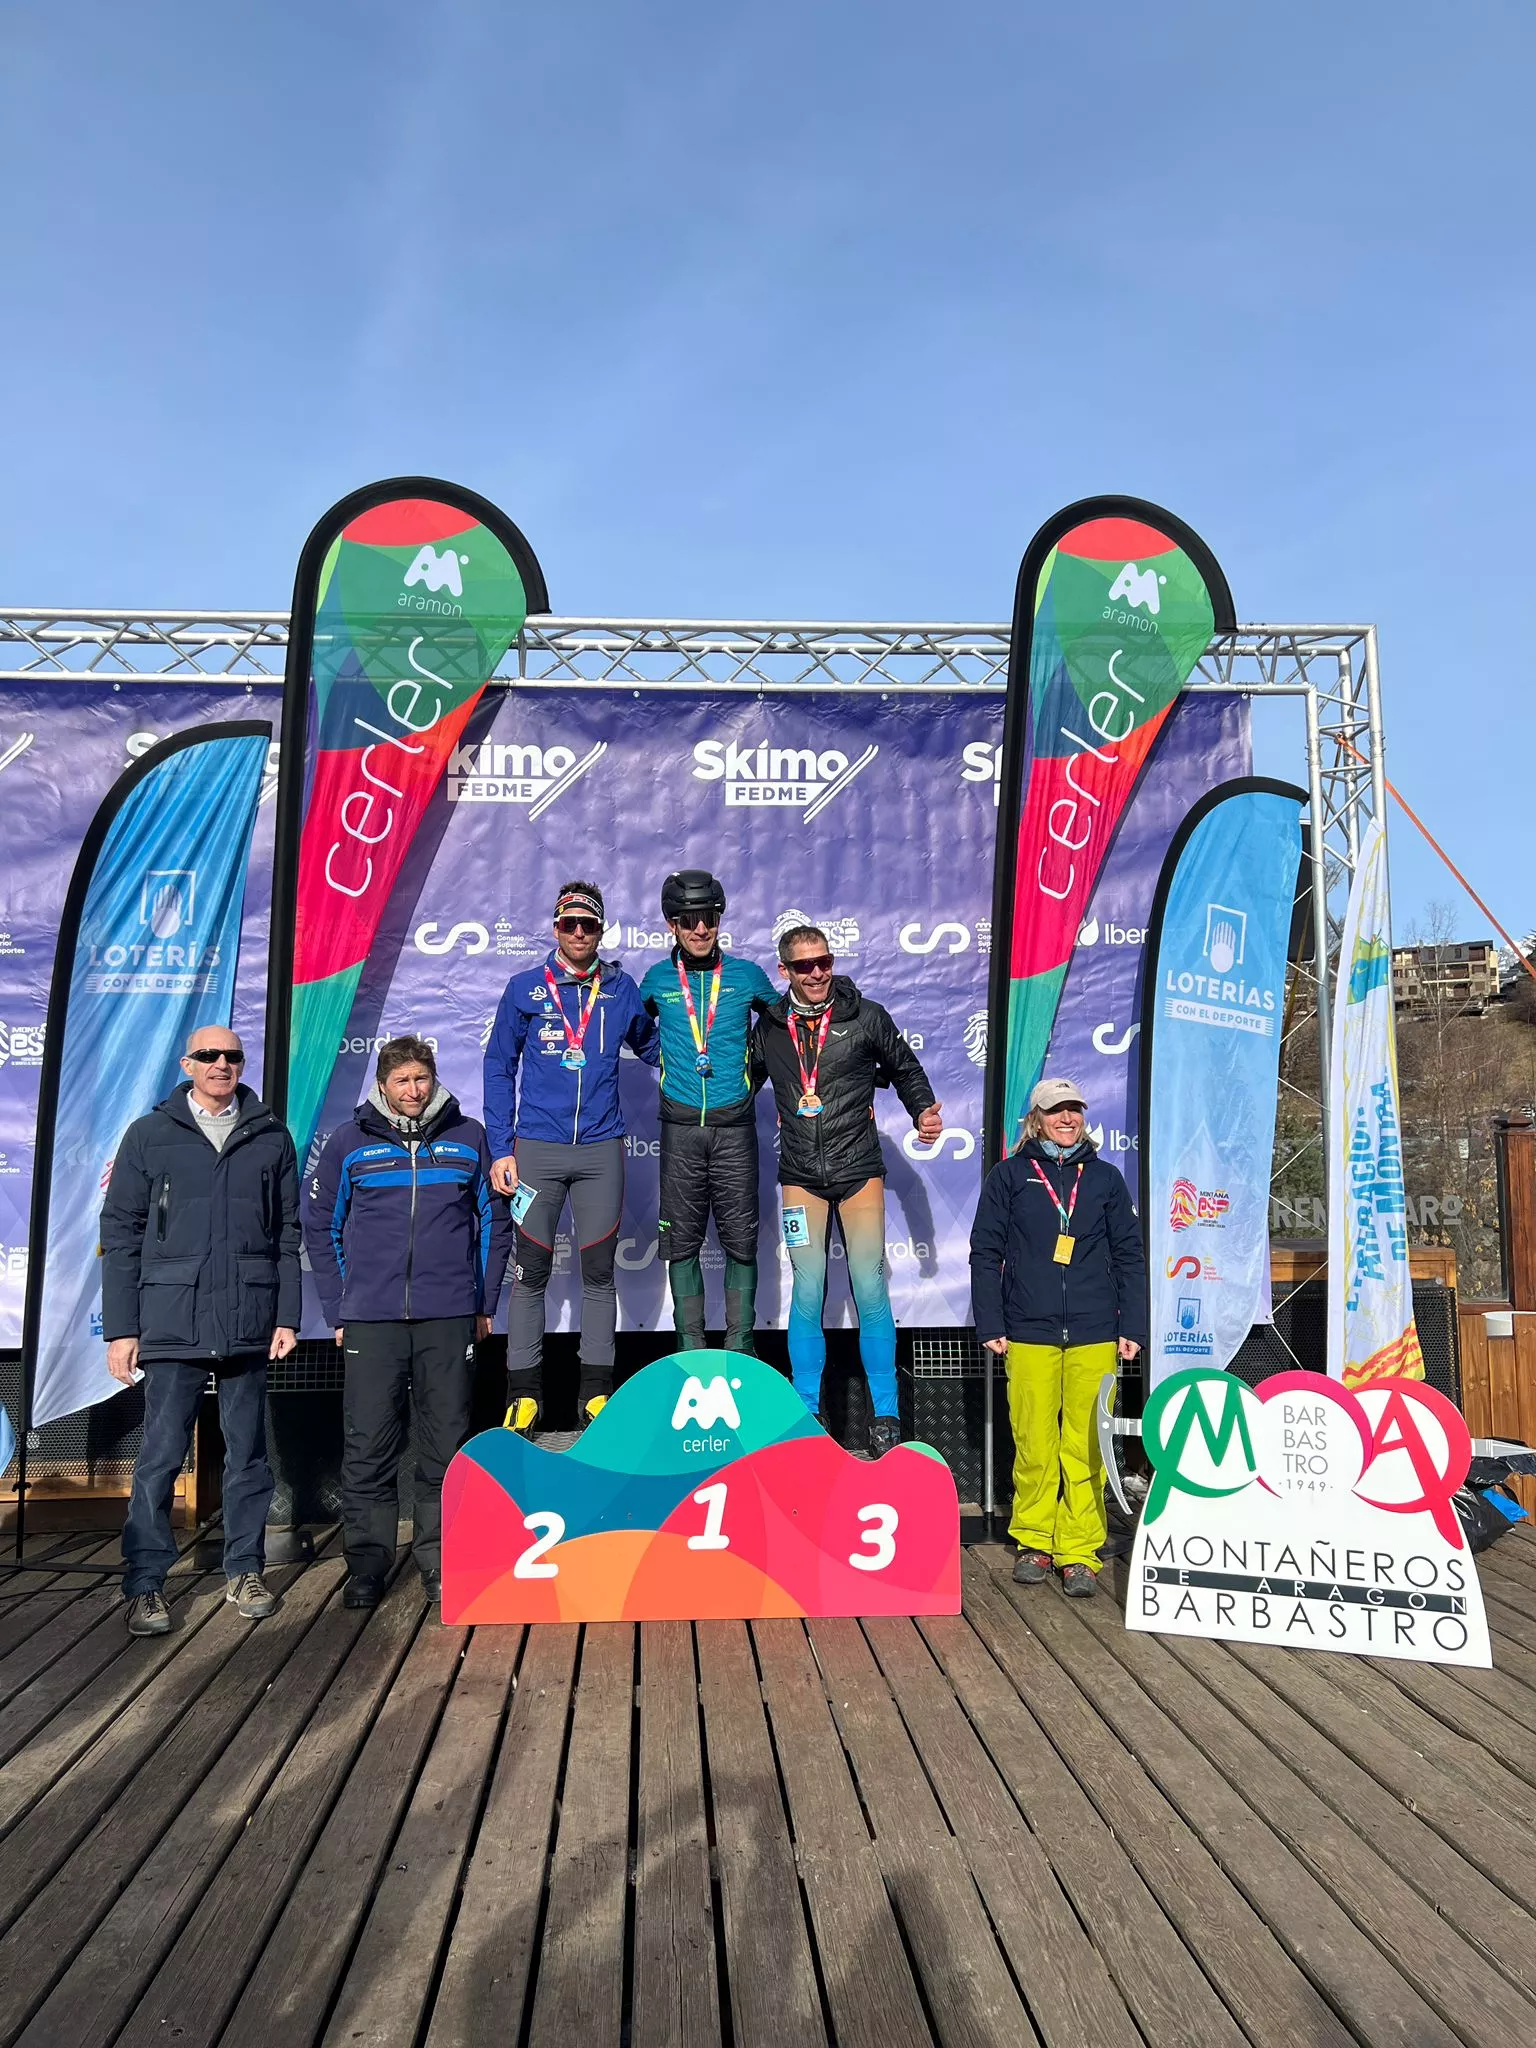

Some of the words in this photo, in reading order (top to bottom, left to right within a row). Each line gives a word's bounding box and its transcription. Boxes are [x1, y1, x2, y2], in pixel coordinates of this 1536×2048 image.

[397, 592, 463, 618] aramon
[1102, 605, 1159, 634] aramon
[325, 636, 454, 898] cerler
[447, 735, 577, 778] kimo
[1037, 648, 1146, 900] cerler
[457, 783, 533, 798] FEDME
[735, 786, 808, 801] FEDME
[815, 917, 859, 928] MONTAÑA
[496, 934, 525, 943] Consejo
[496, 941, 527, 949] Superior
[496, 948, 506, 956] de
[506, 948, 538, 957] Deportes
[102, 978, 131, 990] CON
[135, 978, 151, 990] EL
[1166, 969, 1276, 1011] LOTERÍAS
[1176, 1004, 1196, 1016] CON
[1199, 1009, 1210, 1019] EL
[1212, 1011, 1262, 1029] DEPORTE
[699, 1249, 722, 1258] onsejo
[1283, 1404, 1328, 1427] BAR
[682, 1435, 731, 1453] cerler
[1283, 1428, 1328, 1451] BAS
[1282, 1453, 1329, 1476] TRO
[686, 1482, 731, 1551] 1
[513, 1510, 567, 1580] 2
[848, 1502, 900, 1572] 3
[1143, 1531, 1466, 1592] MONTAÑEROS
[1143, 1565, 1190, 1586] DE
[1142, 1584, 1468, 1651] BARBASTRO
